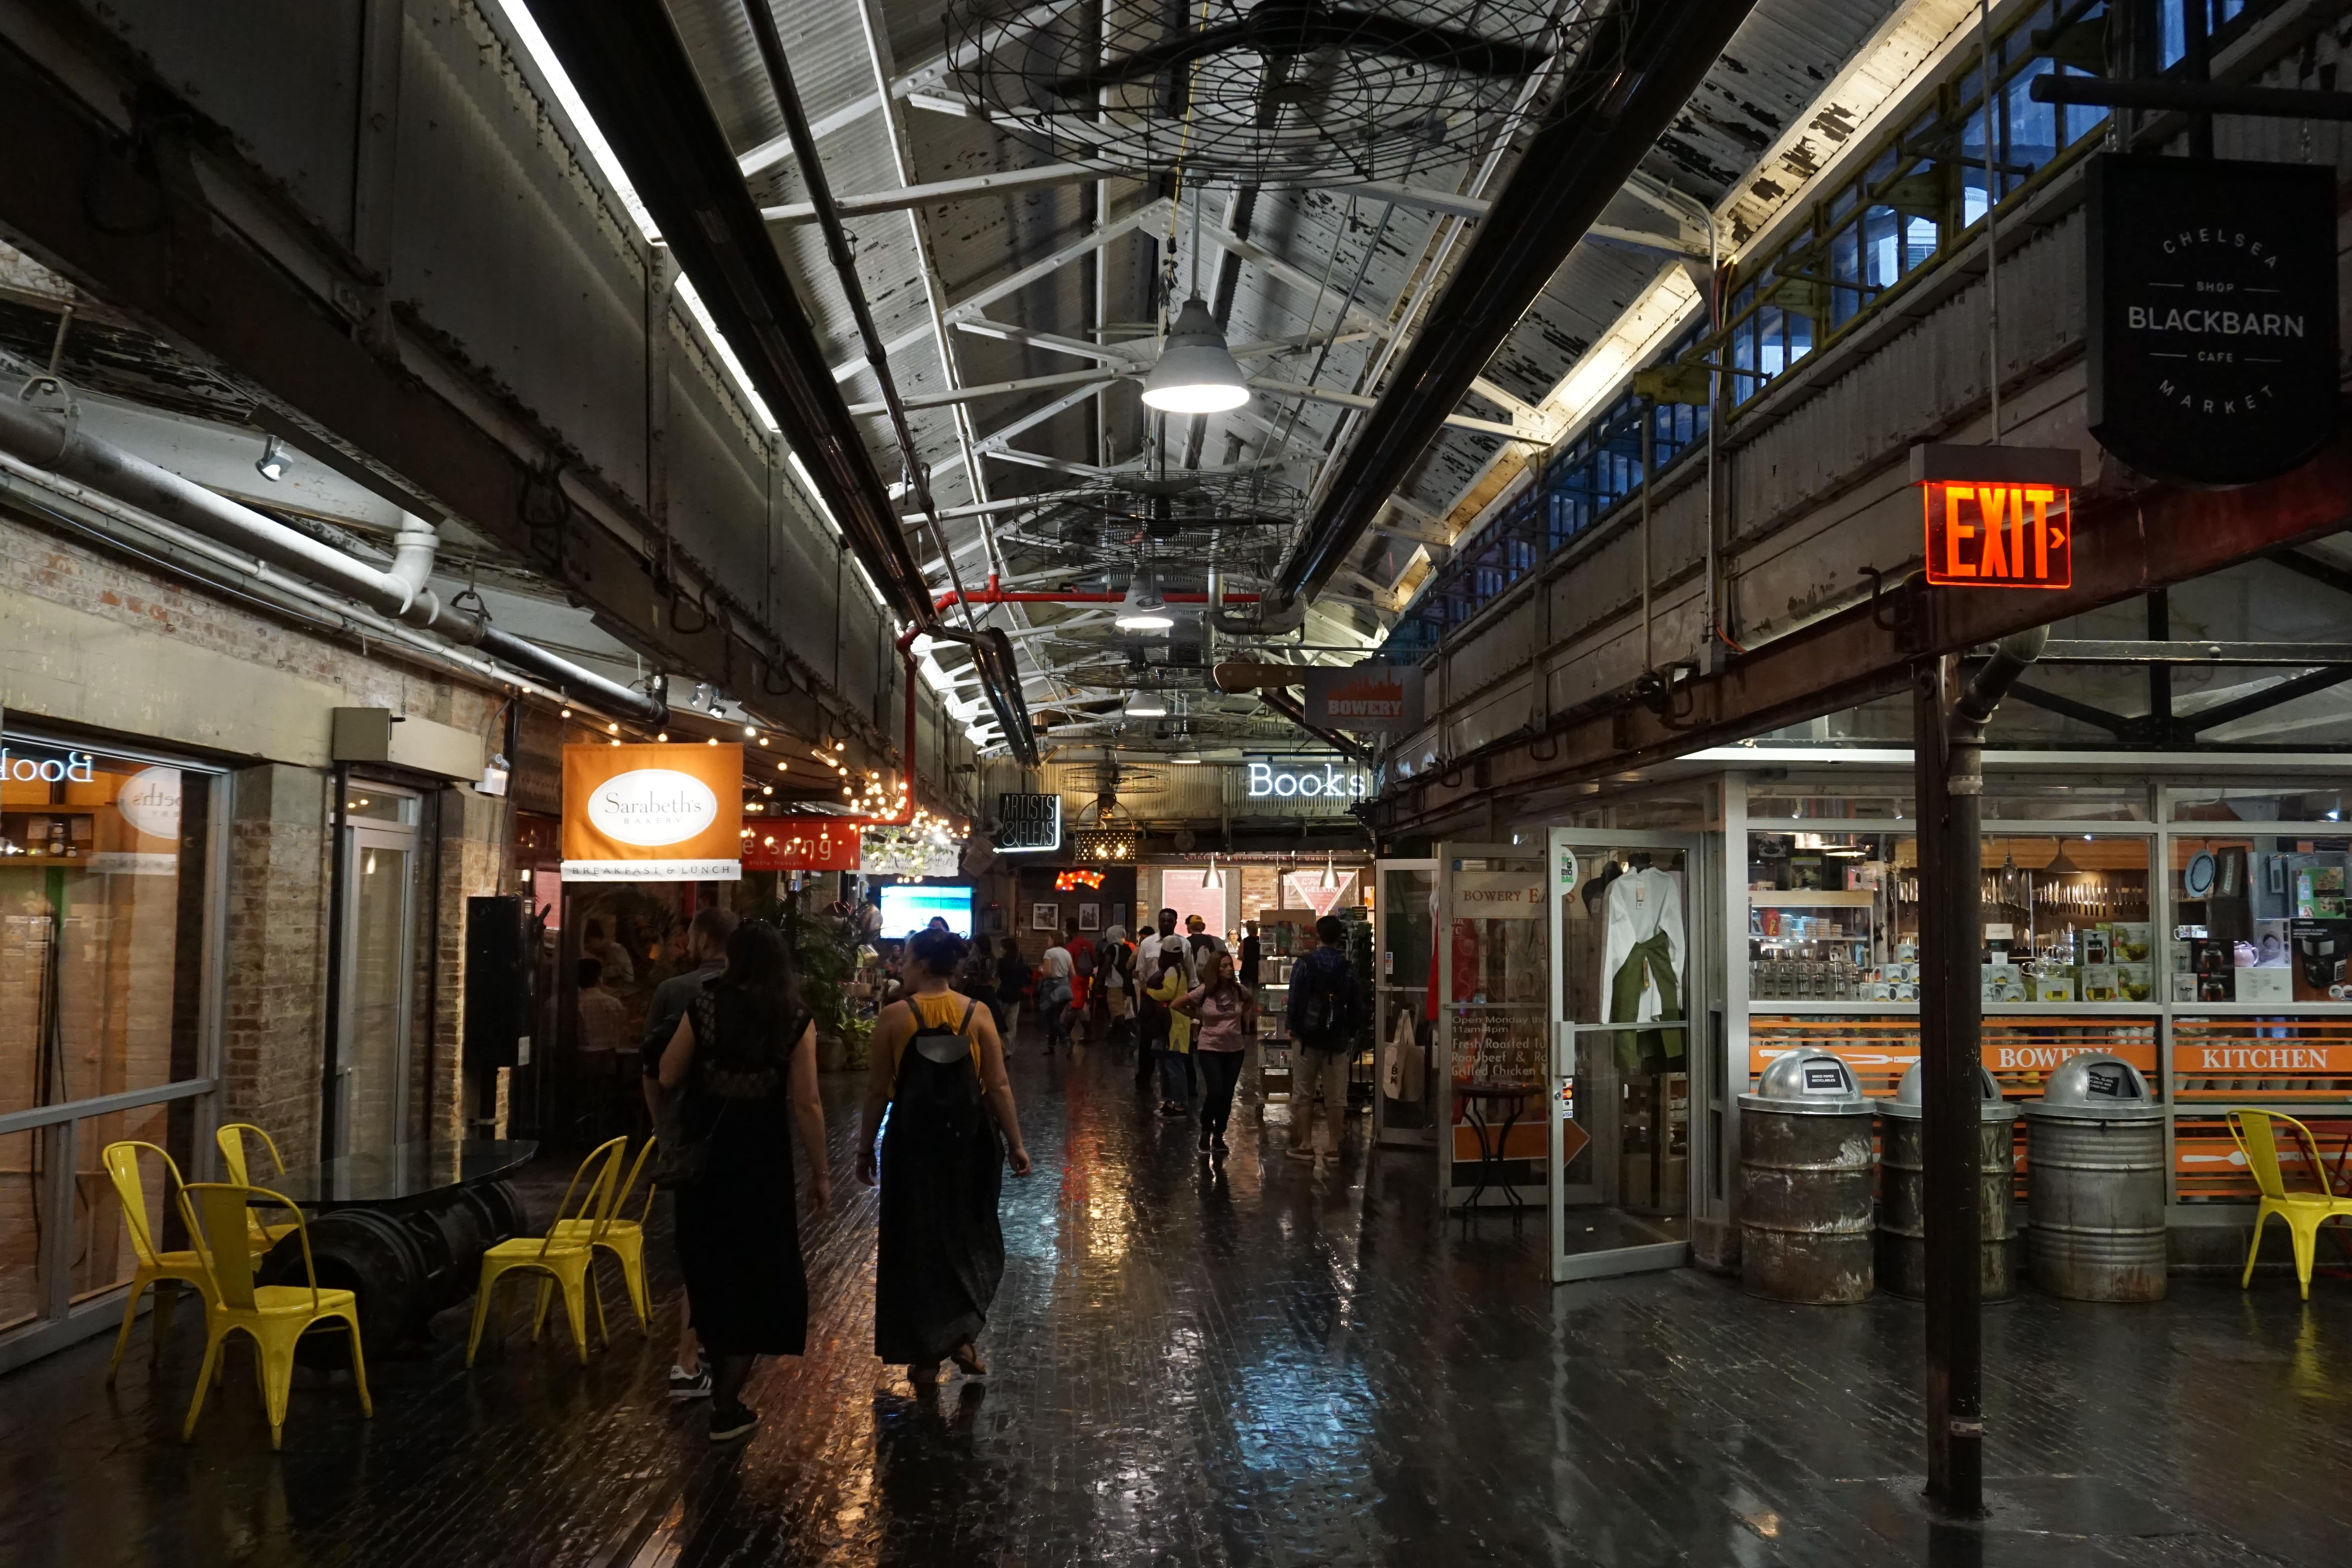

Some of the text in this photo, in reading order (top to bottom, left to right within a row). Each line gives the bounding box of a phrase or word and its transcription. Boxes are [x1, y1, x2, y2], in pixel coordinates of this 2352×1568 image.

[2163, 226, 2277, 268] CHELSEA
[2196, 281, 2235, 292] SHOP
[2128, 306, 2305, 338] BLACKBARN
[2198, 351, 2233, 363] CAFE
[2159, 379, 2274, 414] MARKET
[1946, 486, 2054, 579] EXIT
[1328, 700, 1402, 715] BOWERY
[1248, 764, 1365, 796] Books
[604, 791, 701, 814] Sarabeth's
[1002, 795, 1054, 833] ARTISTS
[1002, 821, 1053, 848] & FLEAS
[766, 839, 831, 860] song
[1464, 891, 1521, 901] BOWERY
[1452, 1016, 1482, 1024] Open
[1452, 1038, 1481, 1049] Fresh
[1486, 1038, 1528, 1049] Roasted
[1998, 1048, 2327, 1069] BOWE KITCHEN
[1452, 1064, 1536, 1076] Grilled Chicken
